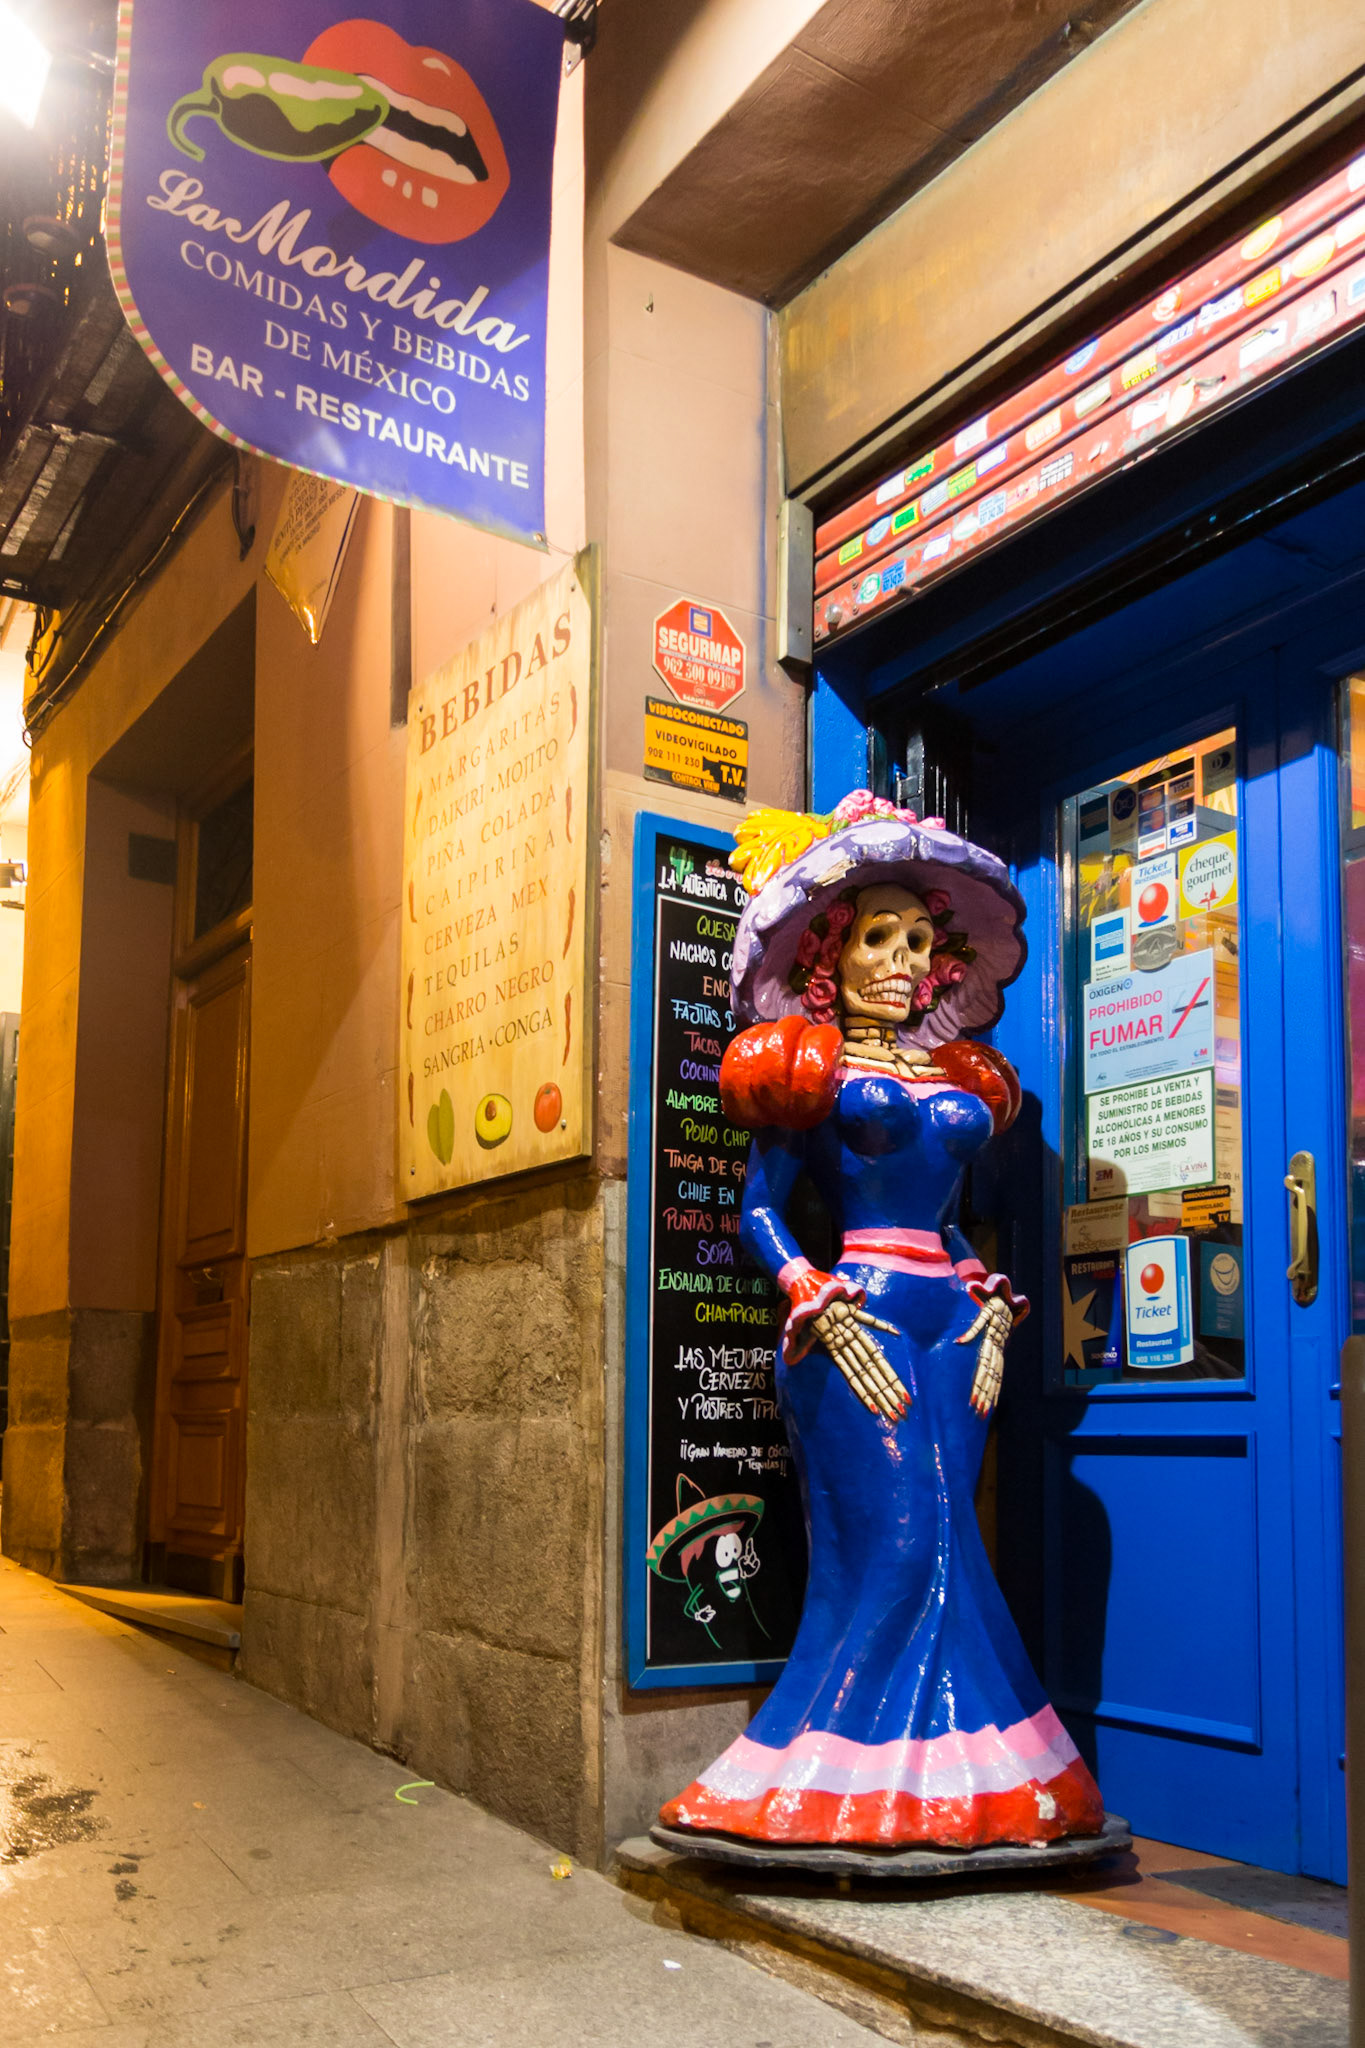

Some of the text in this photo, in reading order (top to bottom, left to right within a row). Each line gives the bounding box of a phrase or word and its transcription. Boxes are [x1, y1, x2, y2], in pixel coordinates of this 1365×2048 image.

[146, 169, 531, 353] La Mordida
[179, 240, 530, 402] COMIDAS Y BEBIDAS
[264, 320, 457, 415] DE MÉXICO
[191, 343, 266, 398] BAR
[296, 384, 530, 490] RESTAURANTE
[658, 626, 741, 669] SEGURMAP
[419, 610, 573, 756] BEBIDAS
[686, 661, 705, 682] 300
[648, 700, 745, 737] VIDEOCONECTADO
[429, 691, 561, 799] MARGARITAS
[647, 746, 664, 758] 902
[667, 751, 682, 763] 111
[684, 757, 700, 768] 230
[655, 729, 738, 759] VIDEOVIGILADO
[428, 737, 560, 838] DAIKIRI MOJITO
[426, 783, 557, 878] PIÑA COLADA
[424, 828, 557, 917] CAIPIRIÑA
[1139, 860, 1168, 877] Ticket
[1186, 862, 1233, 891] gourmet
[1189, 851, 1229, 873] cheque
[658, 866, 677, 891] LA
[681, 873, 728, 901] AUTENTICA
[423, 903, 498, 957] CERVEZA
[423, 932, 520, 998] TEQUILAS
[669, 940, 717, 970] NACHOS
[423, 960, 554, 1038] CHARRO NEGRO
[1089, 978, 1133, 1000] OXIGENO
[670, 998, 722, 1029] FAJITAS
[1089, 990, 1163, 1020] PROHIBIDO
[423, 1006, 553, 1080] SANGRIA CONGA
[683, 1031, 722, 1058] TACOS
[1090, 1014, 1163, 1051] FUMAR
[665, 1088, 719, 1114] ALAMBRE
[1098, 1102, 1148, 1121] SUMINISTRO
[1151, 1099, 1162, 1110] DE
[1165, 1090, 1203, 1107] BEBIDAS
[1100, 1076, 1200, 1107] SE PROHIBE LA VENTA Y
[1155, 1114, 1162, 1123] A
[1163, 1104, 1206, 1121] MENORES
[679, 1117, 718, 1145] POLLO
[1092, 1118, 1208, 1149] DE 18 AÑOS Y SU CONSUMO
[663, 1149, 704, 1175] TINGA
[708, 1156, 728, 1176] DE
[1113, 1137, 1187, 1159] POR LOS MISMOS
[678, 1179, 735, 1206] CHILE EN
[662, 1207, 714, 1233] PUNTAS
[696, 1240, 734, 1266] SOPA
[658, 1268, 714, 1293] ENSALADA
[716, 1274, 733, 1293] DE
[1135, 1304, 1172, 1319] Ticket
[674, 1345, 705, 1371] LAS
[698, 1367, 767, 1392] CERVEZAS
[678, 1397, 689, 1420] Y
[690, 1392, 743, 1420] POSTRES
[751, 1446, 764, 1459] DE
